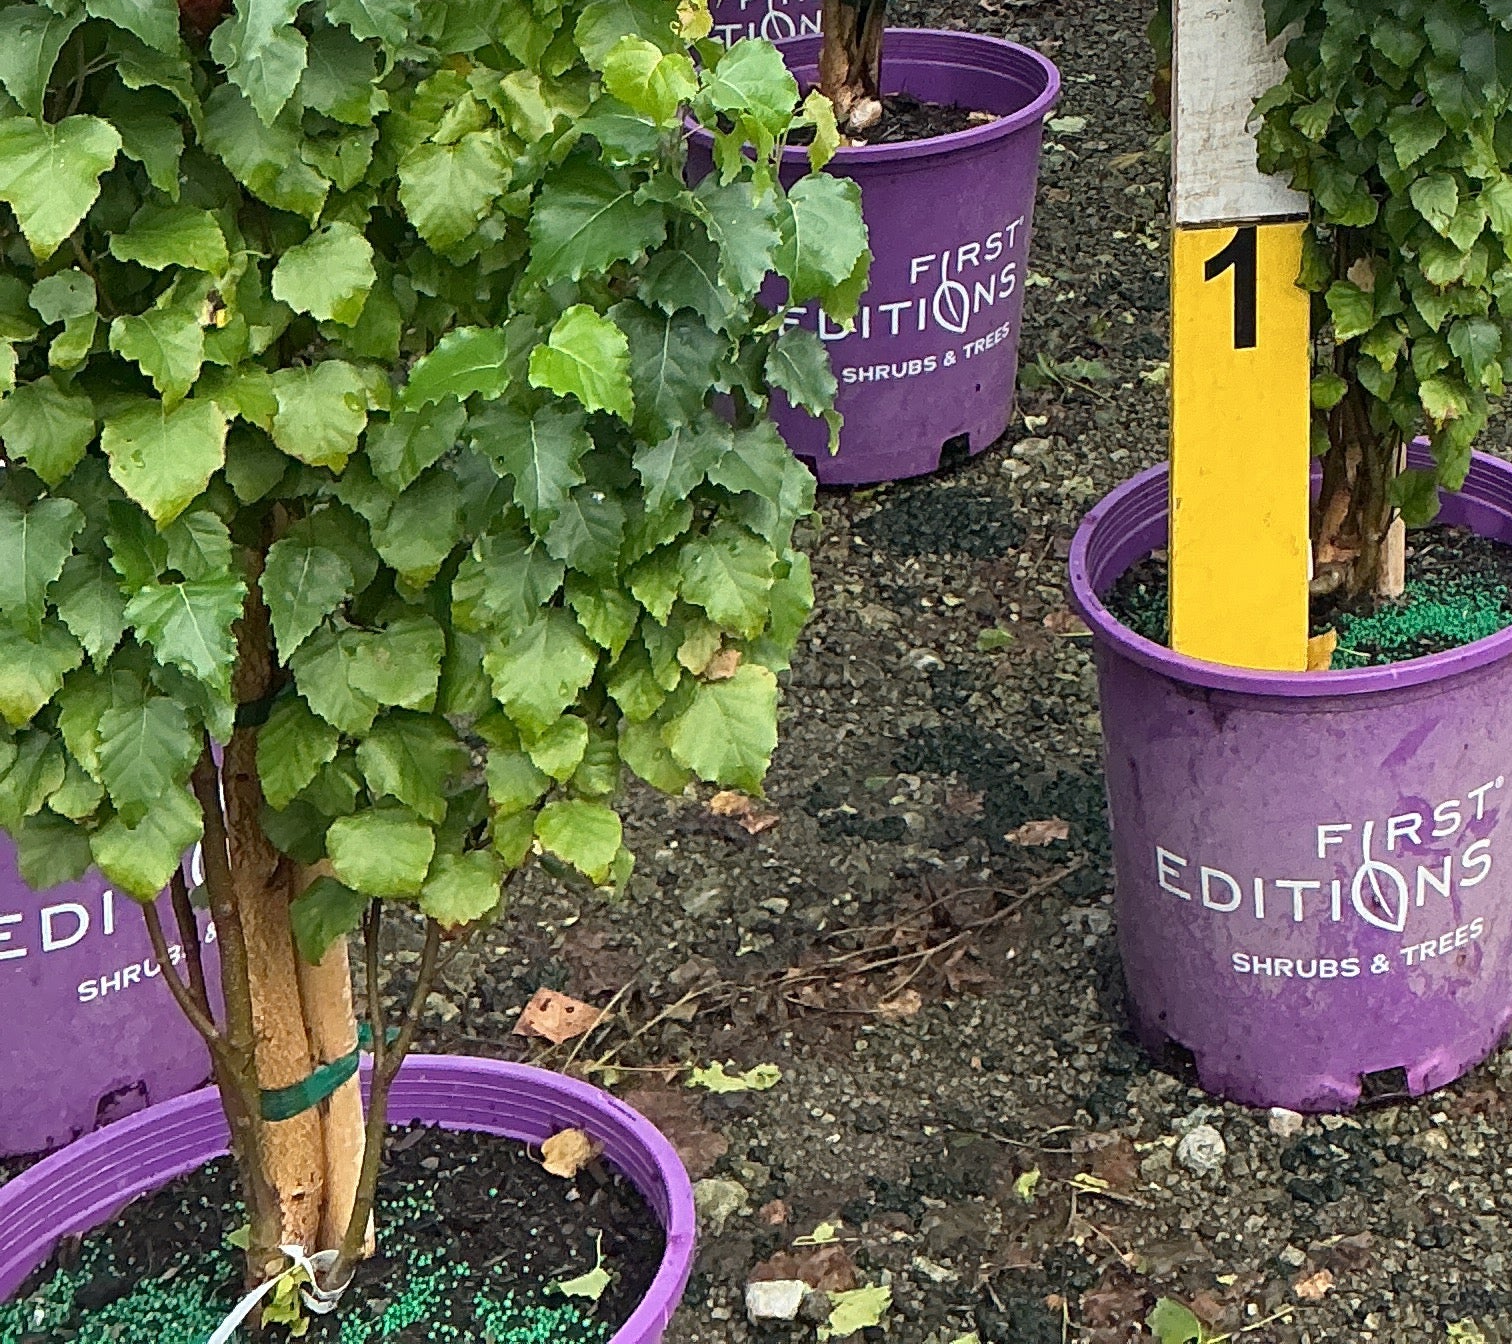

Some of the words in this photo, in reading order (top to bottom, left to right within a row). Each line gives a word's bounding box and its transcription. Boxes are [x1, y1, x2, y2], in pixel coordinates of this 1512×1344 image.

[1204, 225, 1258, 350] 1
[842, 355, 937, 383] SHRUBS
[943, 351, 957, 367] &
[962, 322, 1010, 359] TREES
[1156, 838, 1493, 933] EDITIONS
[1232, 952, 1361, 979] SHRUBS
[1370, 954, 1390, 975] &
[1400, 917, 1484, 967] TREES
